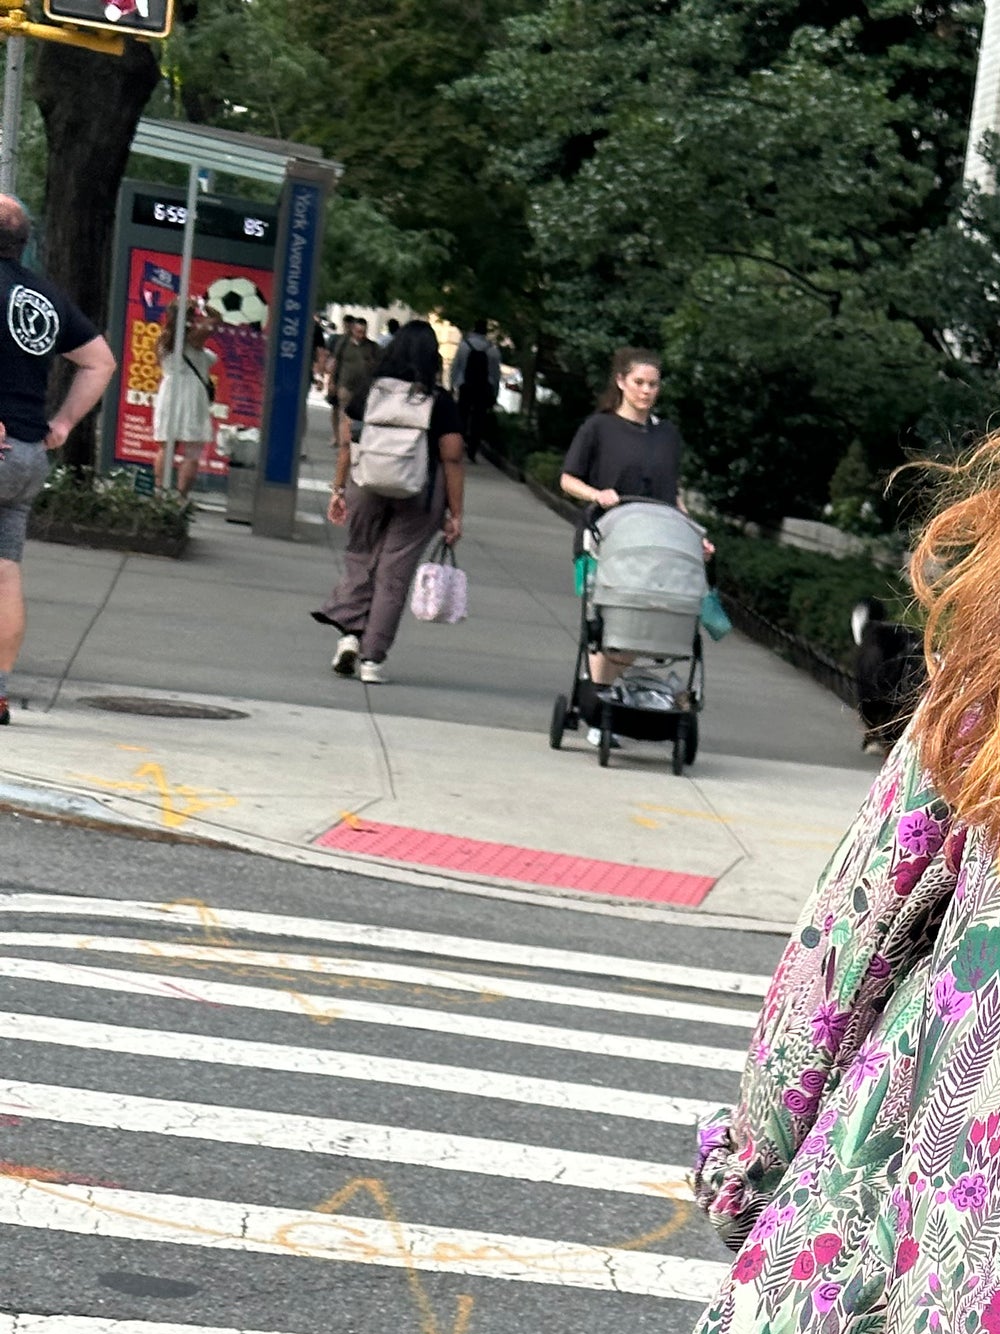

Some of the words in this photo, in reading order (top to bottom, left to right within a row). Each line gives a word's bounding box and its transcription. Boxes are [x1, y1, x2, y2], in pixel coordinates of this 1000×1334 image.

[292, 193, 312, 230] York
[286, 232, 307, 296] Avenue
[285, 299, 302, 311] &
[282, 316, 300, 336] 76
[281, 340, 297, 359] St
